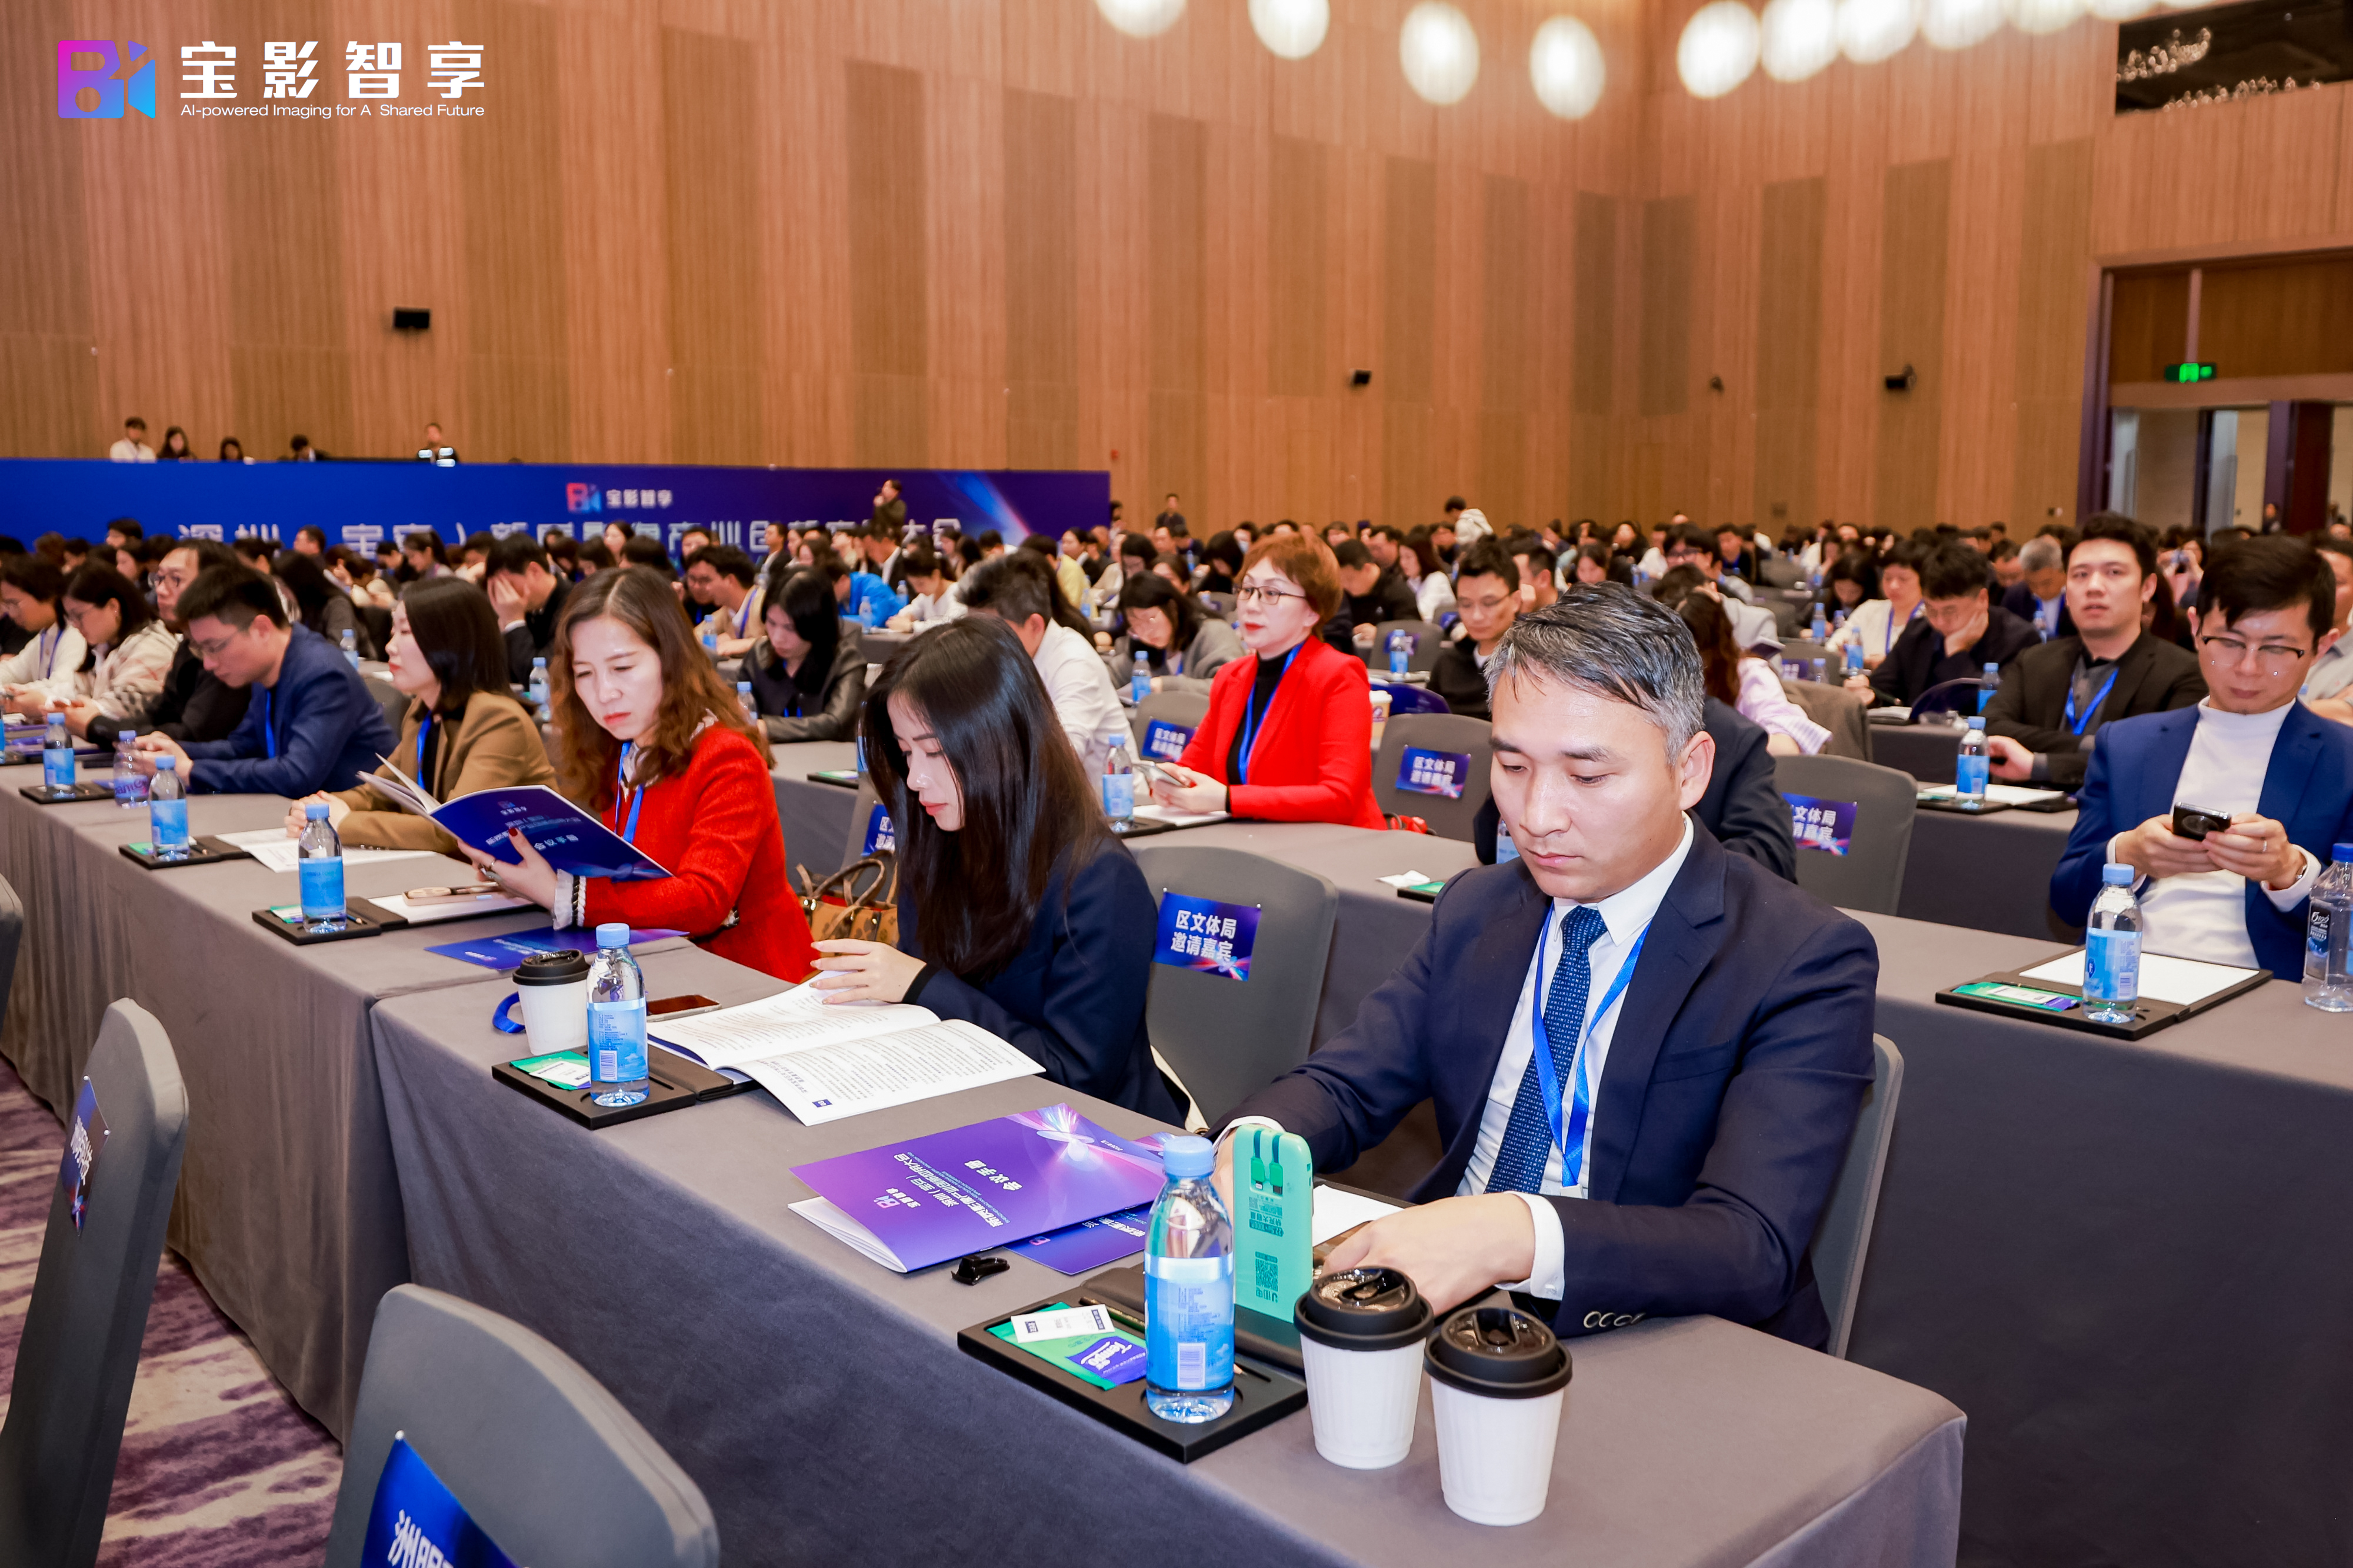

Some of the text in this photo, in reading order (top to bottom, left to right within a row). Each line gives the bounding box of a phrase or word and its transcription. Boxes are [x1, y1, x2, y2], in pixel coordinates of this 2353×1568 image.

[1791, 805, 1836, 827] 文体局
[1175, 909, 1237, 939] 区文体局
[1171, 931, 1233, 962] 邀请嘉宾
[964, 1159, 1022, 1190] 会议手册
[885, 1187, 921, 1208] 宝影智享
[1083, 1340, 1133, 1368] Tempo
